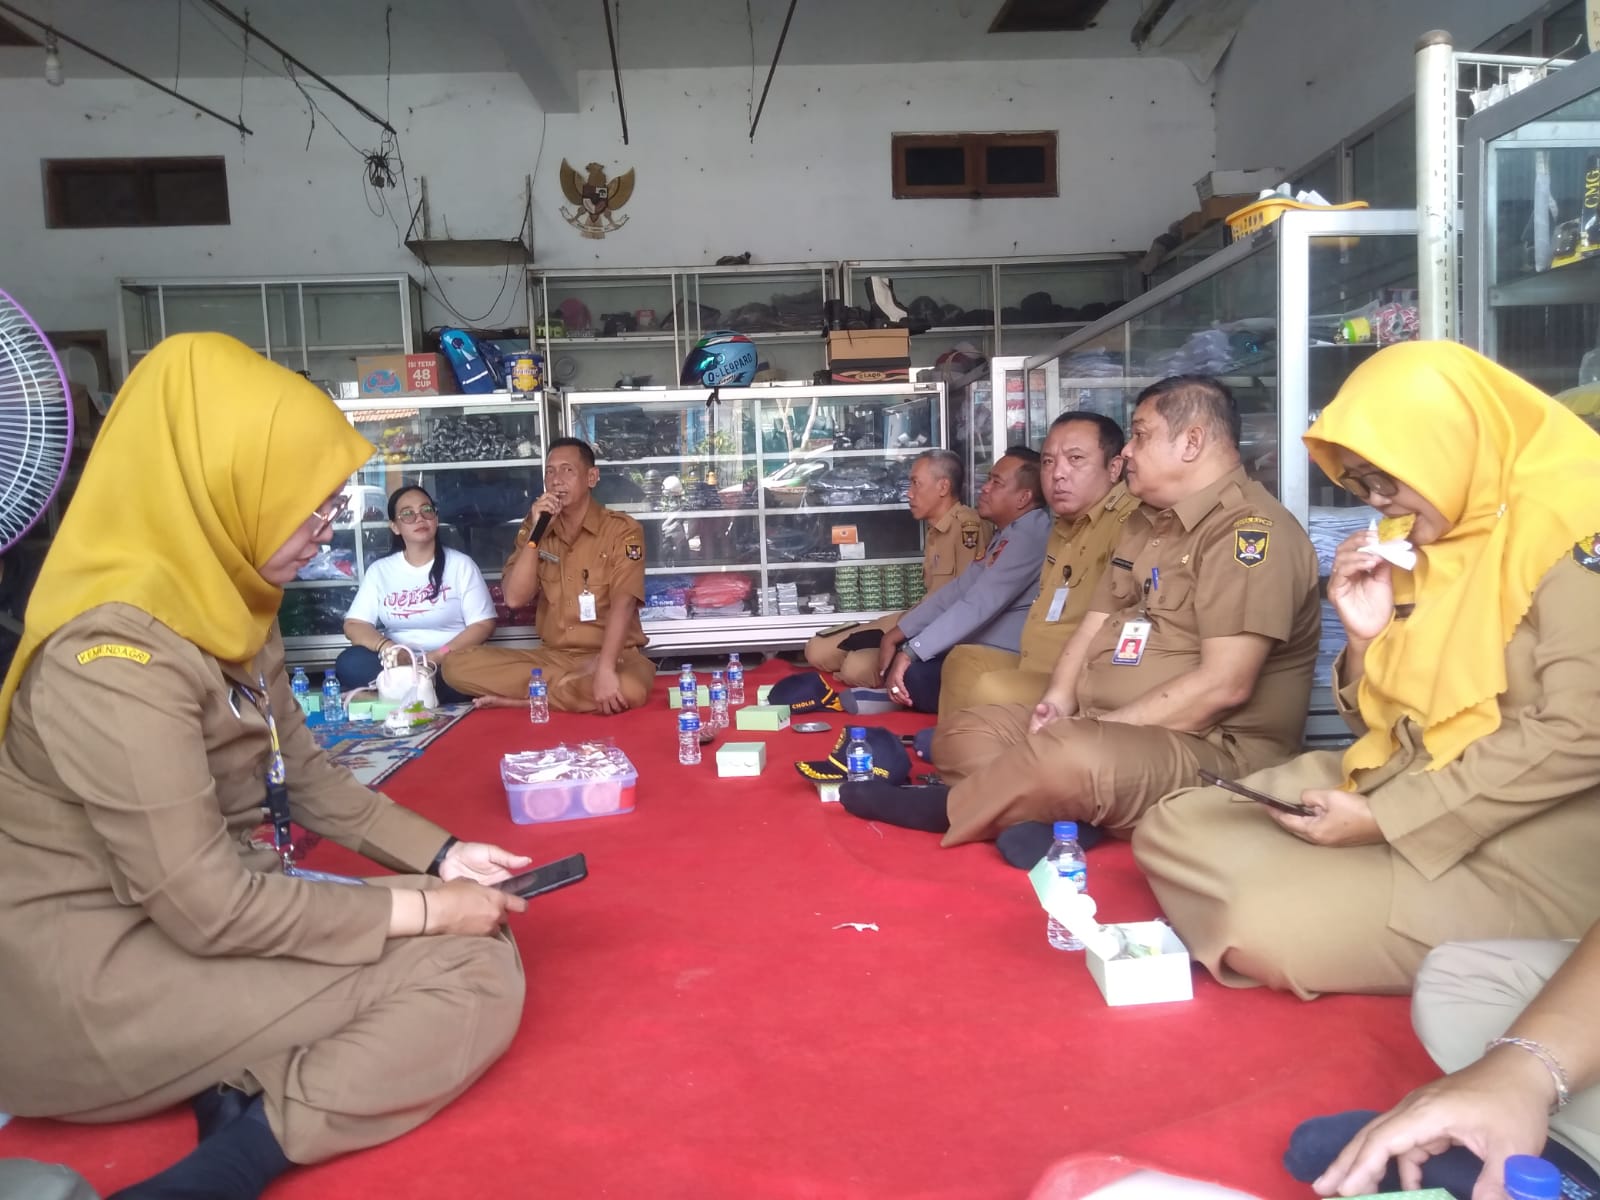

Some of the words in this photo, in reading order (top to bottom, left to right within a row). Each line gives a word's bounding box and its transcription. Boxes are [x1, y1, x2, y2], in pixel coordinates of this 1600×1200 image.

[418, 360, 436, 368] TETAP
[719, 353, 754, 376] LEOPARD
[412, 368, 431, 380] 48
[415, 380, 432, 388] CUP
[79, 645, 148, 662] KEMENDAGRI
